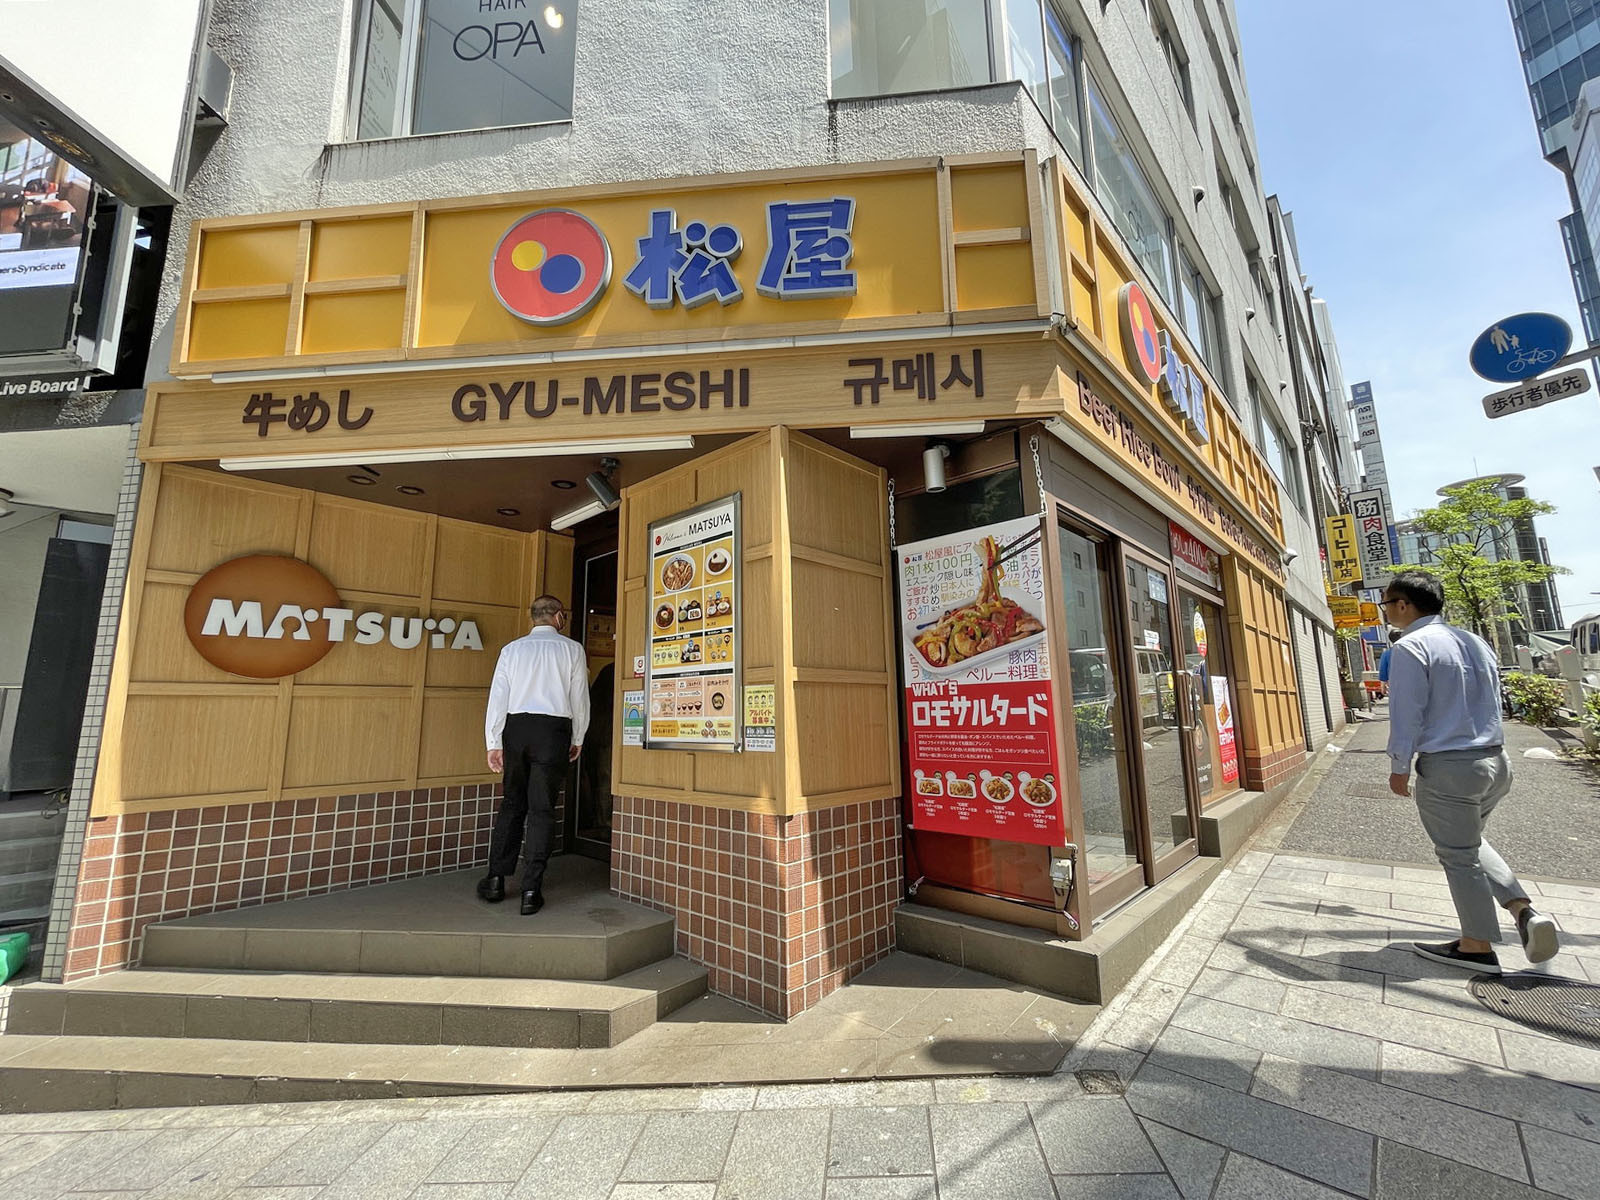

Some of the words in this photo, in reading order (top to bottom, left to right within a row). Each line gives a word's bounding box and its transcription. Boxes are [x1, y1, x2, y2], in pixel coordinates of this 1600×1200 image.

[479, 0, 527, 13] HAIR
[453, 19, 546, 62] OPA
[623, 194, 858, 311] 松屋
[0, 381, 27, 396] ive
[28, 378, 79, 395] Board
[450, 367, 750, 423] GYU-MESHI
[843, 348, 985, 410] 규메시
[1491, 375, 1582, 413] 歩行者優先
[241, 389, 374, 437] 牛めし
[688, 512, 732, 536] MATSUYA
[1332, 518, 1350, 559] コーヒー
[1355, 499, 1389, 563] 筋肉食堂
[200, 597, 485, 652] MATSUYA
[911, 678, 958, 697] WHAT'S
[966, 663, 1039, 682] ペルー料理
[911, 693, 1049, 727] ロモサルタード
